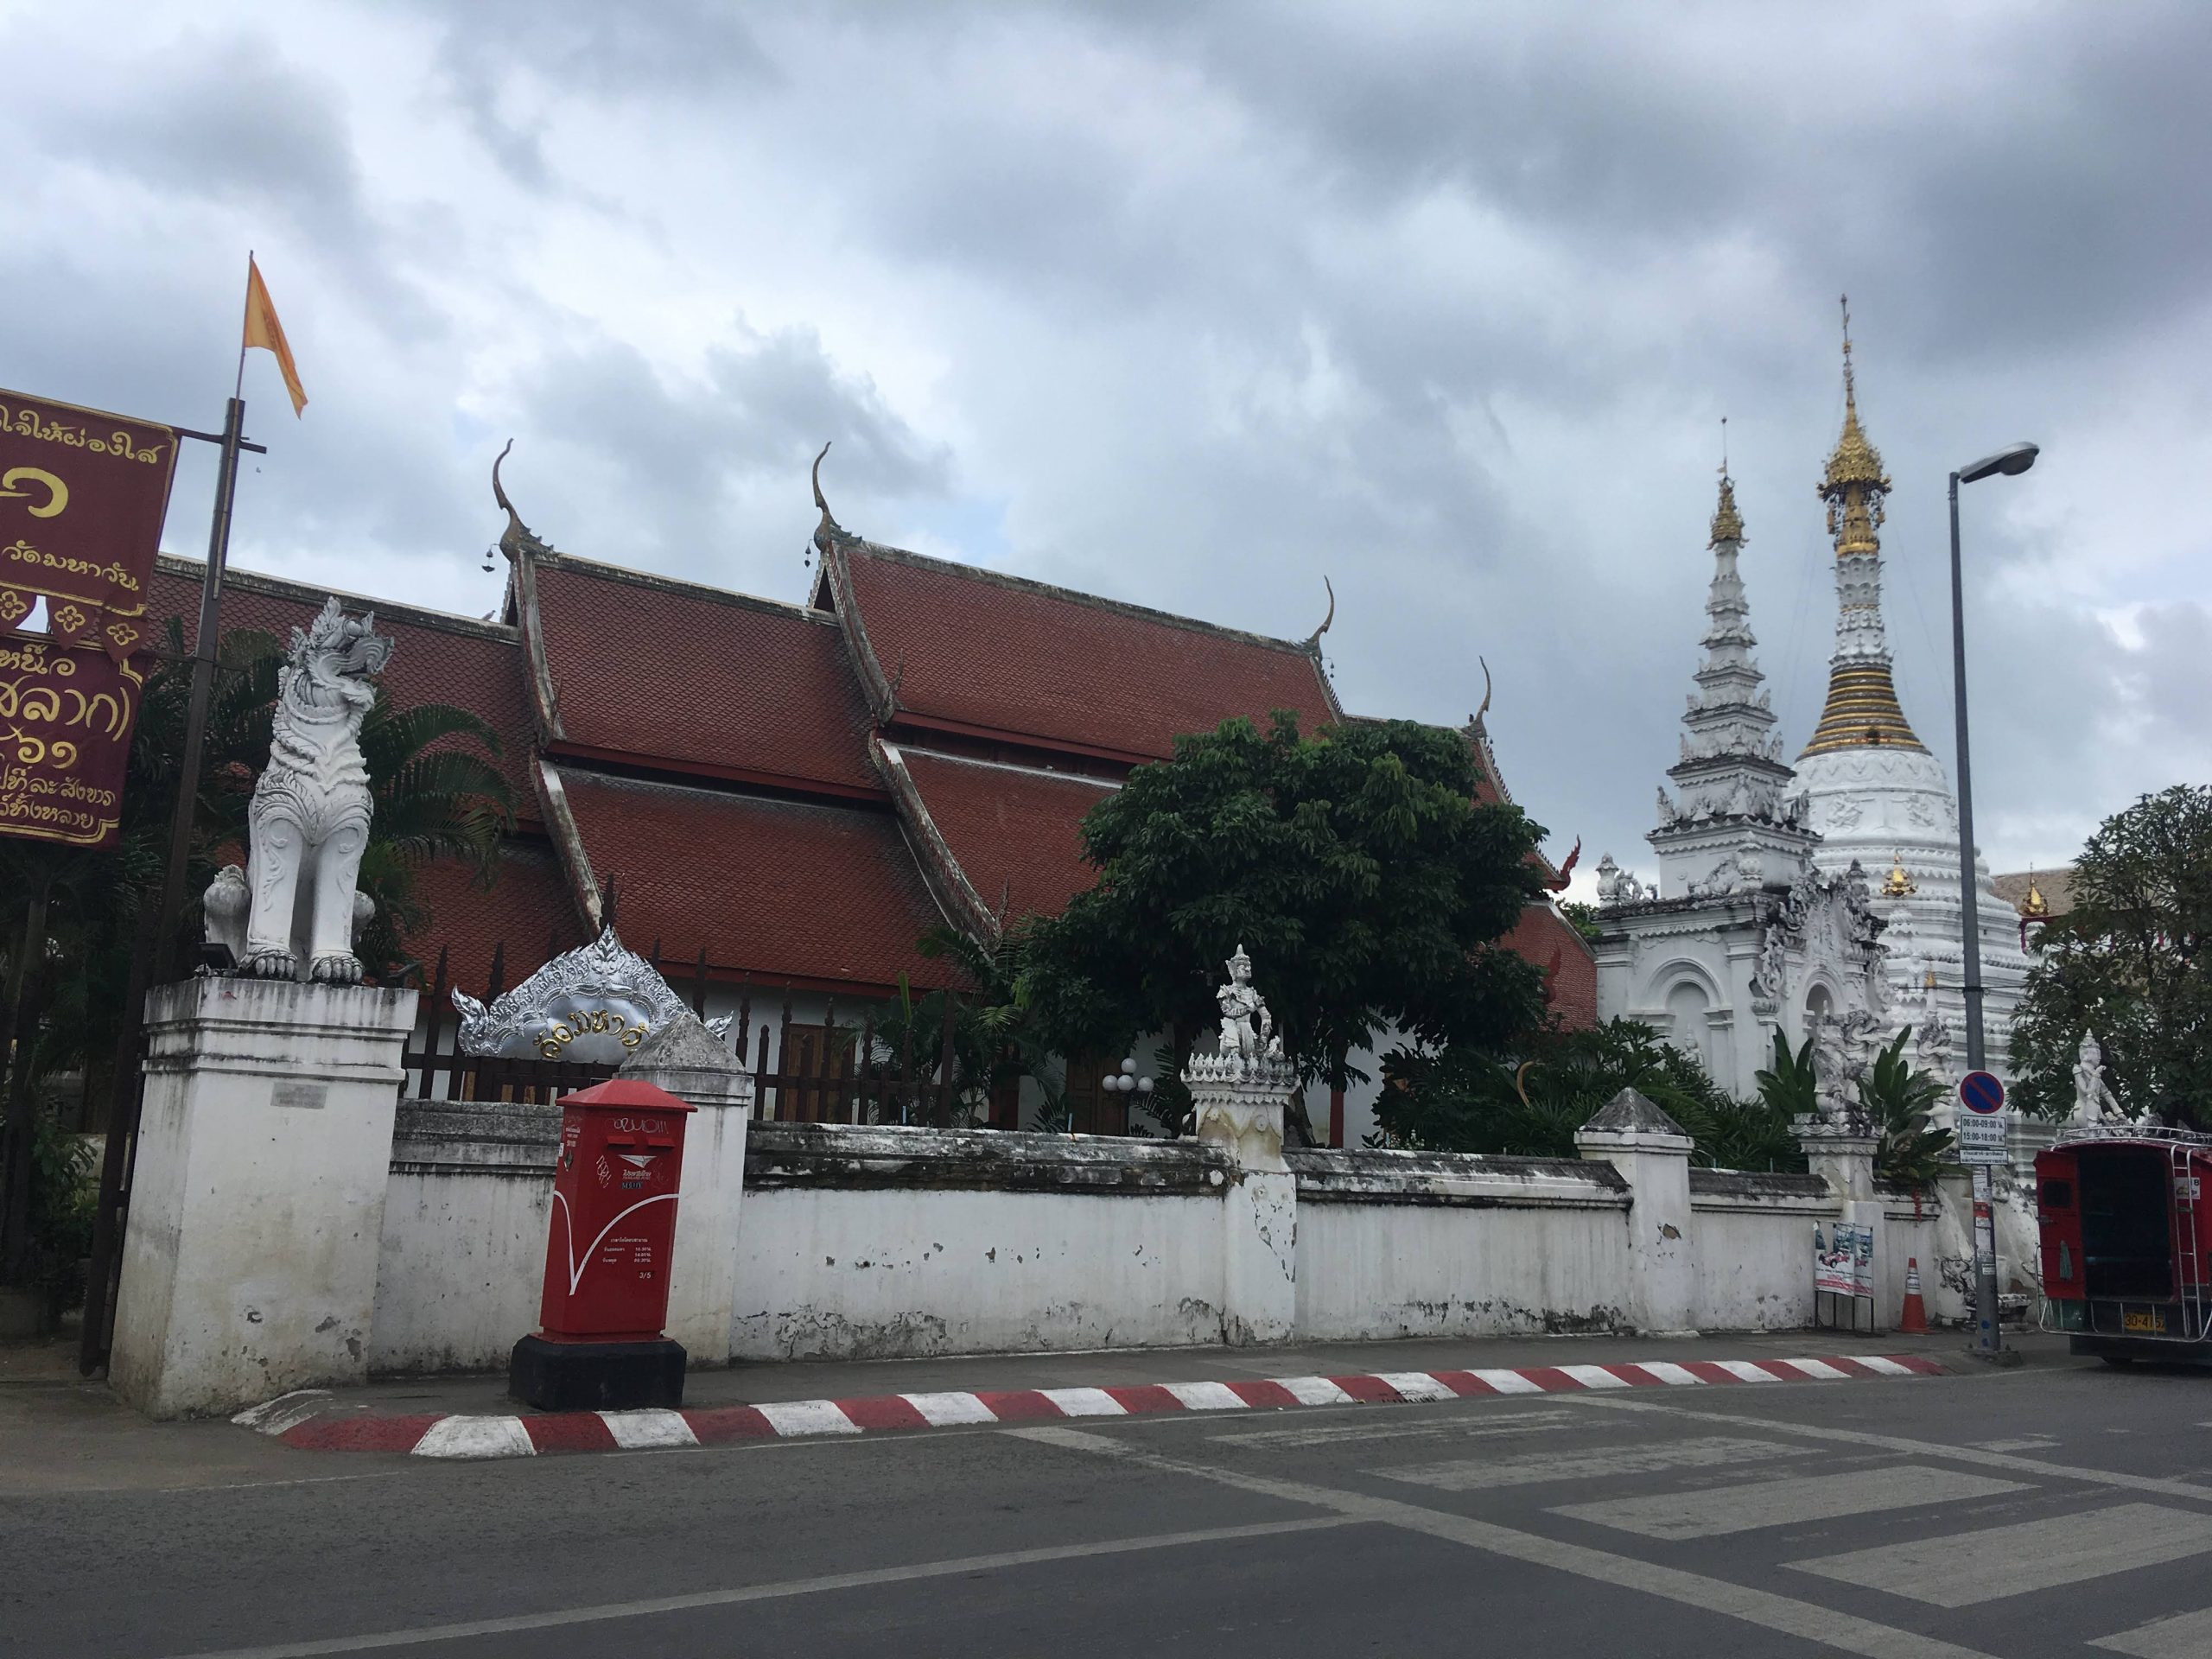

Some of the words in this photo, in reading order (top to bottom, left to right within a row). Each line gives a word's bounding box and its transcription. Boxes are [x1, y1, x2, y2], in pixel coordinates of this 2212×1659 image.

[2, 539, 140, 591] วัดมหาวัน
[532, 1008, 651, 1059] วัดมหาวั
